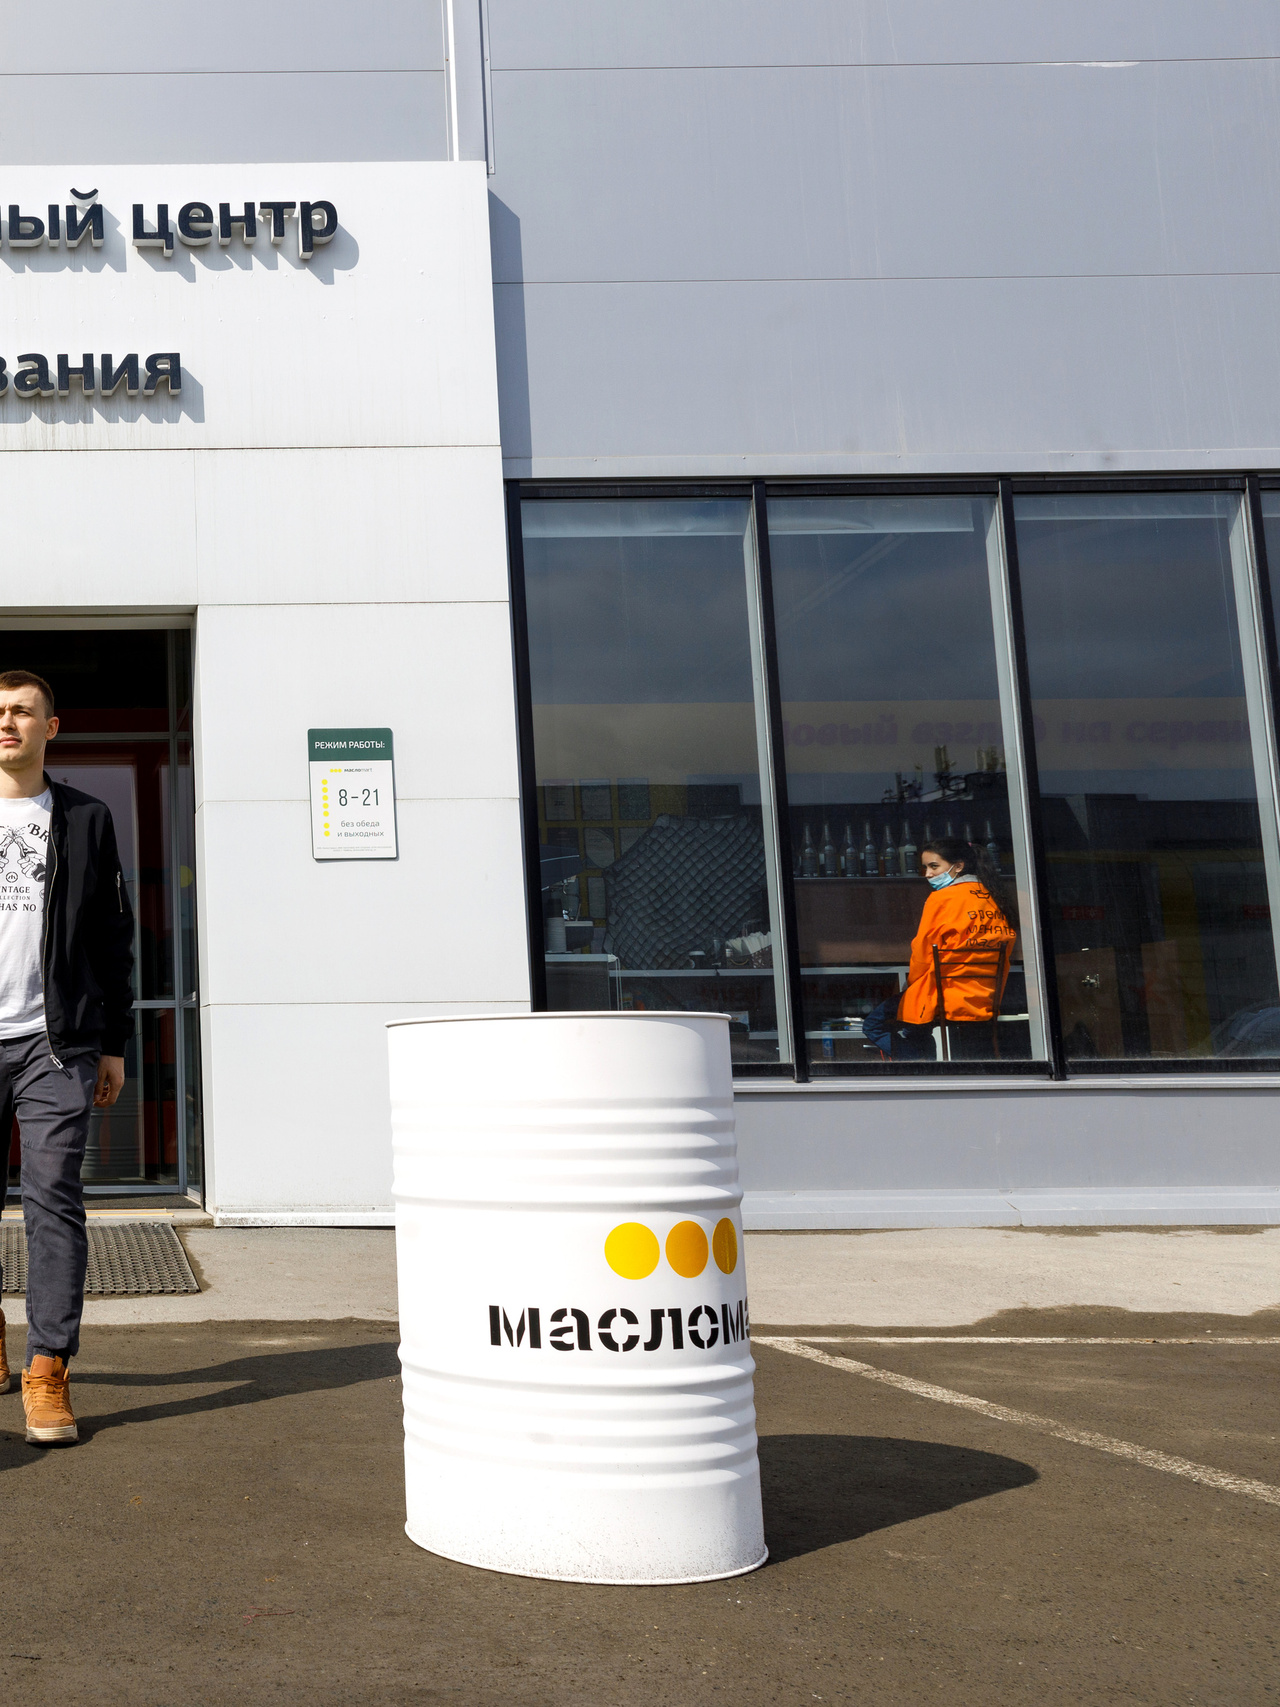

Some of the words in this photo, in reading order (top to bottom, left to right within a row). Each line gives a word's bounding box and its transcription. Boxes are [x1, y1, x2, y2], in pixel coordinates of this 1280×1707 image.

[132, 200, 338, 258] центр
[314, 741, 347, 750] РЕЖИМ
[348, 740, 386, 749] РАБОТЫ:
[340, 820, 355, 828] без
[356, 820, 380, 828] обеда
[22, 903, 37, 912] NO
[967, 909, 1006, 922] врем
[965, 923, 1016, 937] менять
